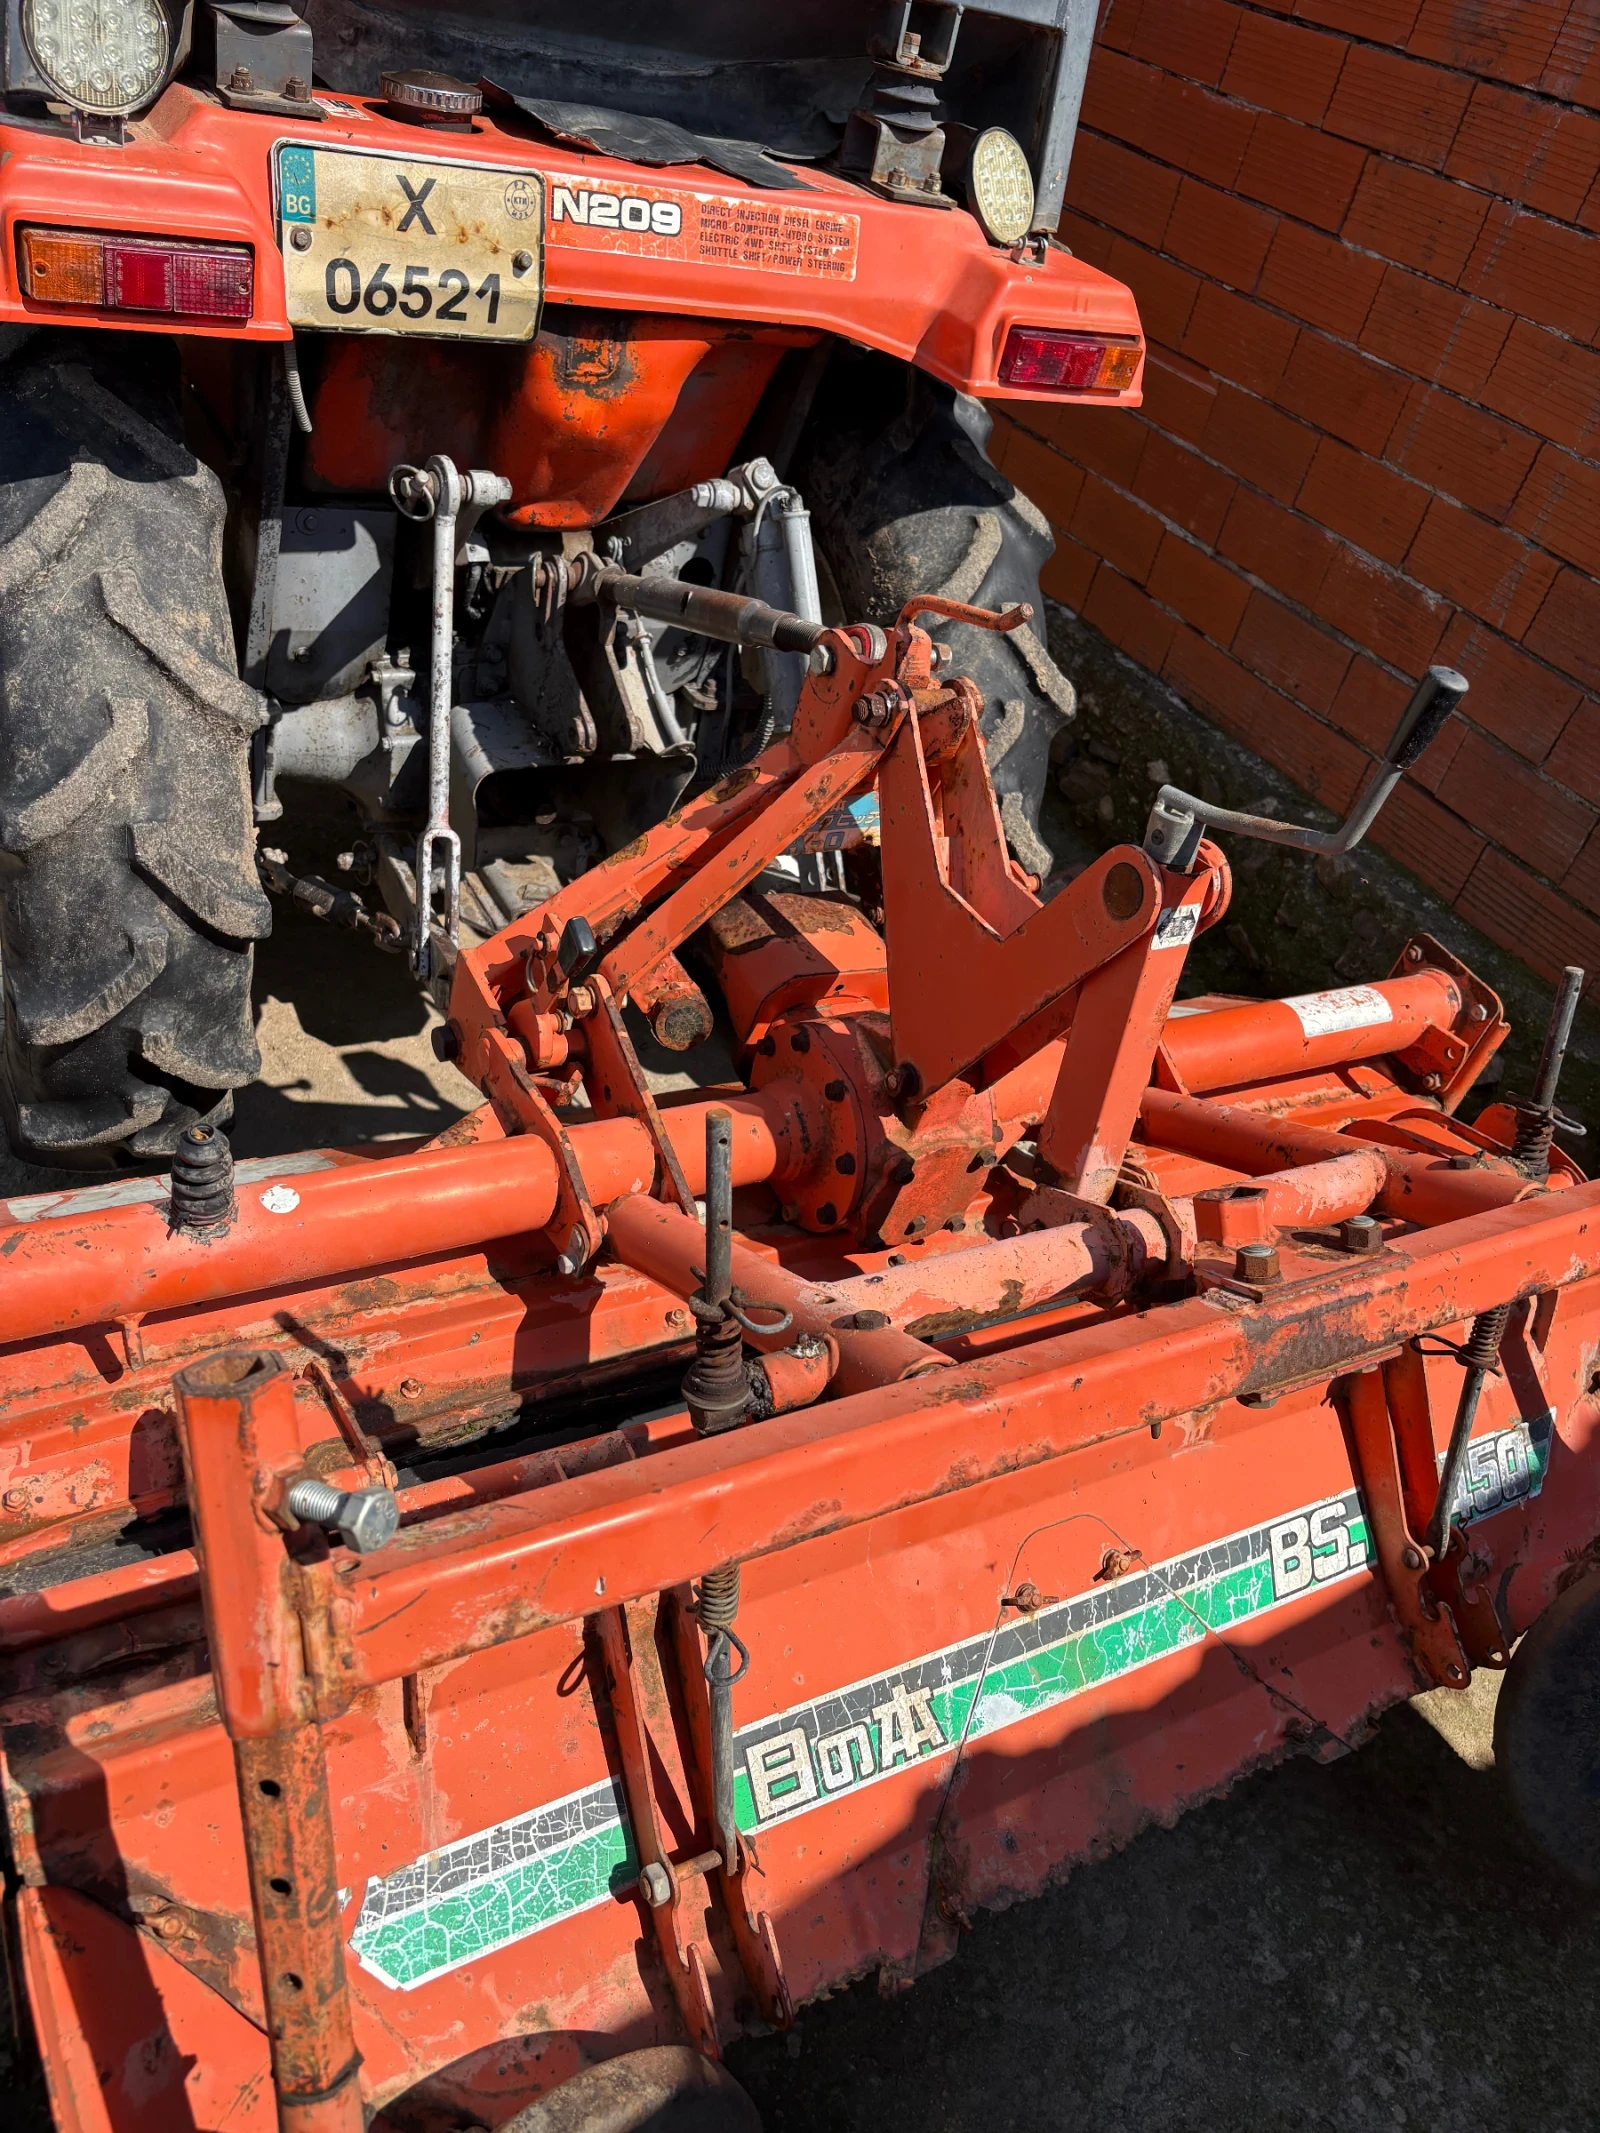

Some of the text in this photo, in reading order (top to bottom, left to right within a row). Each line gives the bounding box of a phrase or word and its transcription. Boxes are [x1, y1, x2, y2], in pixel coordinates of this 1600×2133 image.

[286, 194, 311, 214] BG
[396, 174, 437, 235] X
[551, 185, 682, 237] N209
[701, 204, 843, 233] DIRECT INJECTION DIESEL ENGINE
[700, 232, 829, 257] ELECTRIC 4WD SHIFT SYSTEM
[817, 233, 850, 247] SYSTEM
[699, 245, 737, 258] SHUTTLE
[808, 258, 845, 272] STEERING
[325, 257, 500, 324] 06521
